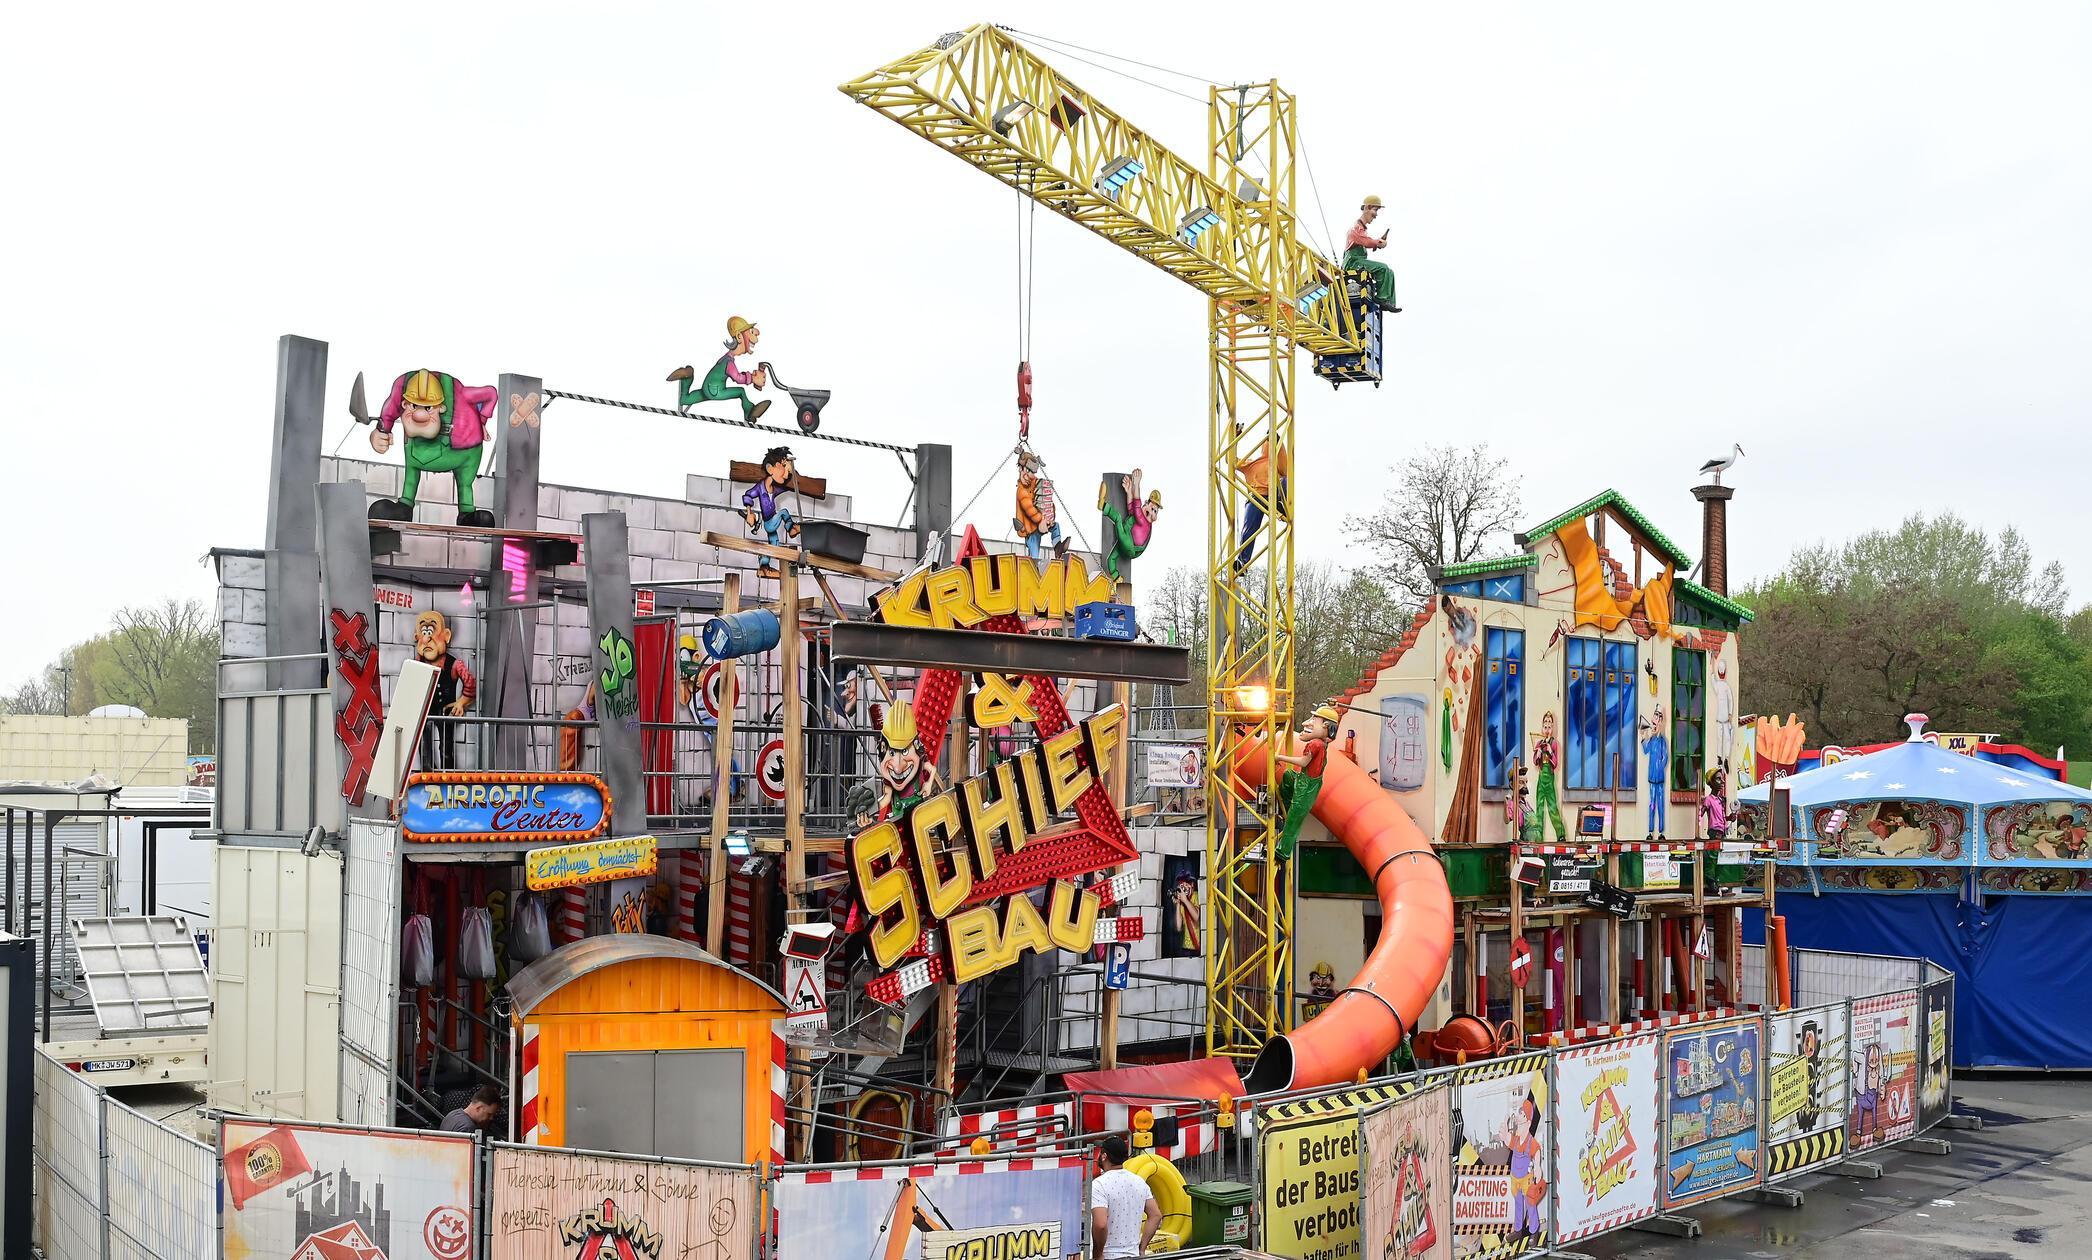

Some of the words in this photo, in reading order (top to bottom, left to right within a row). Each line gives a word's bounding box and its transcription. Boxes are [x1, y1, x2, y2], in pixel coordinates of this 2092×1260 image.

[870, 553, 1114, 629] KRUMM
[1948, 736, 1967, 750] XXL
[424, 784, 546, 810] AIRROTIC
[490, 800, 586, 831] Center
[846, 702, 1128, 969] SCHIEF
[941, 877, 1101, 986] BAU
[1112, 945, 1128, 973] P
[91, 1062, 101, 1070] MK
[106, 1061, 115, 1069] JW
[117, 1060, 129, 1068] 571
[248, 1152, 273, 1172] 100%
[1298, 1130, 1358, 1166] Betret
[1696, 1146, 1732, 1164] HARTMANN
[501, 1166, 558, 1190] Theresia
[560, 1165, 632, 1197] Hartmann
[634, 1173, 648, 1193] &
[1276, 1179, 1309, 1208] der
[1315, 1170, 1359, 1200] Baus
[1458, 1179, 1508, 1198] ACHTUNG
[1294, 1202, 1359, 1241] verbot
[1455, 1201, 1509, 1219] BAUSTELLE!
[558, 1197, 663, 1260] KRUMM
[1351, 1240, 1360, 1254] Ih
